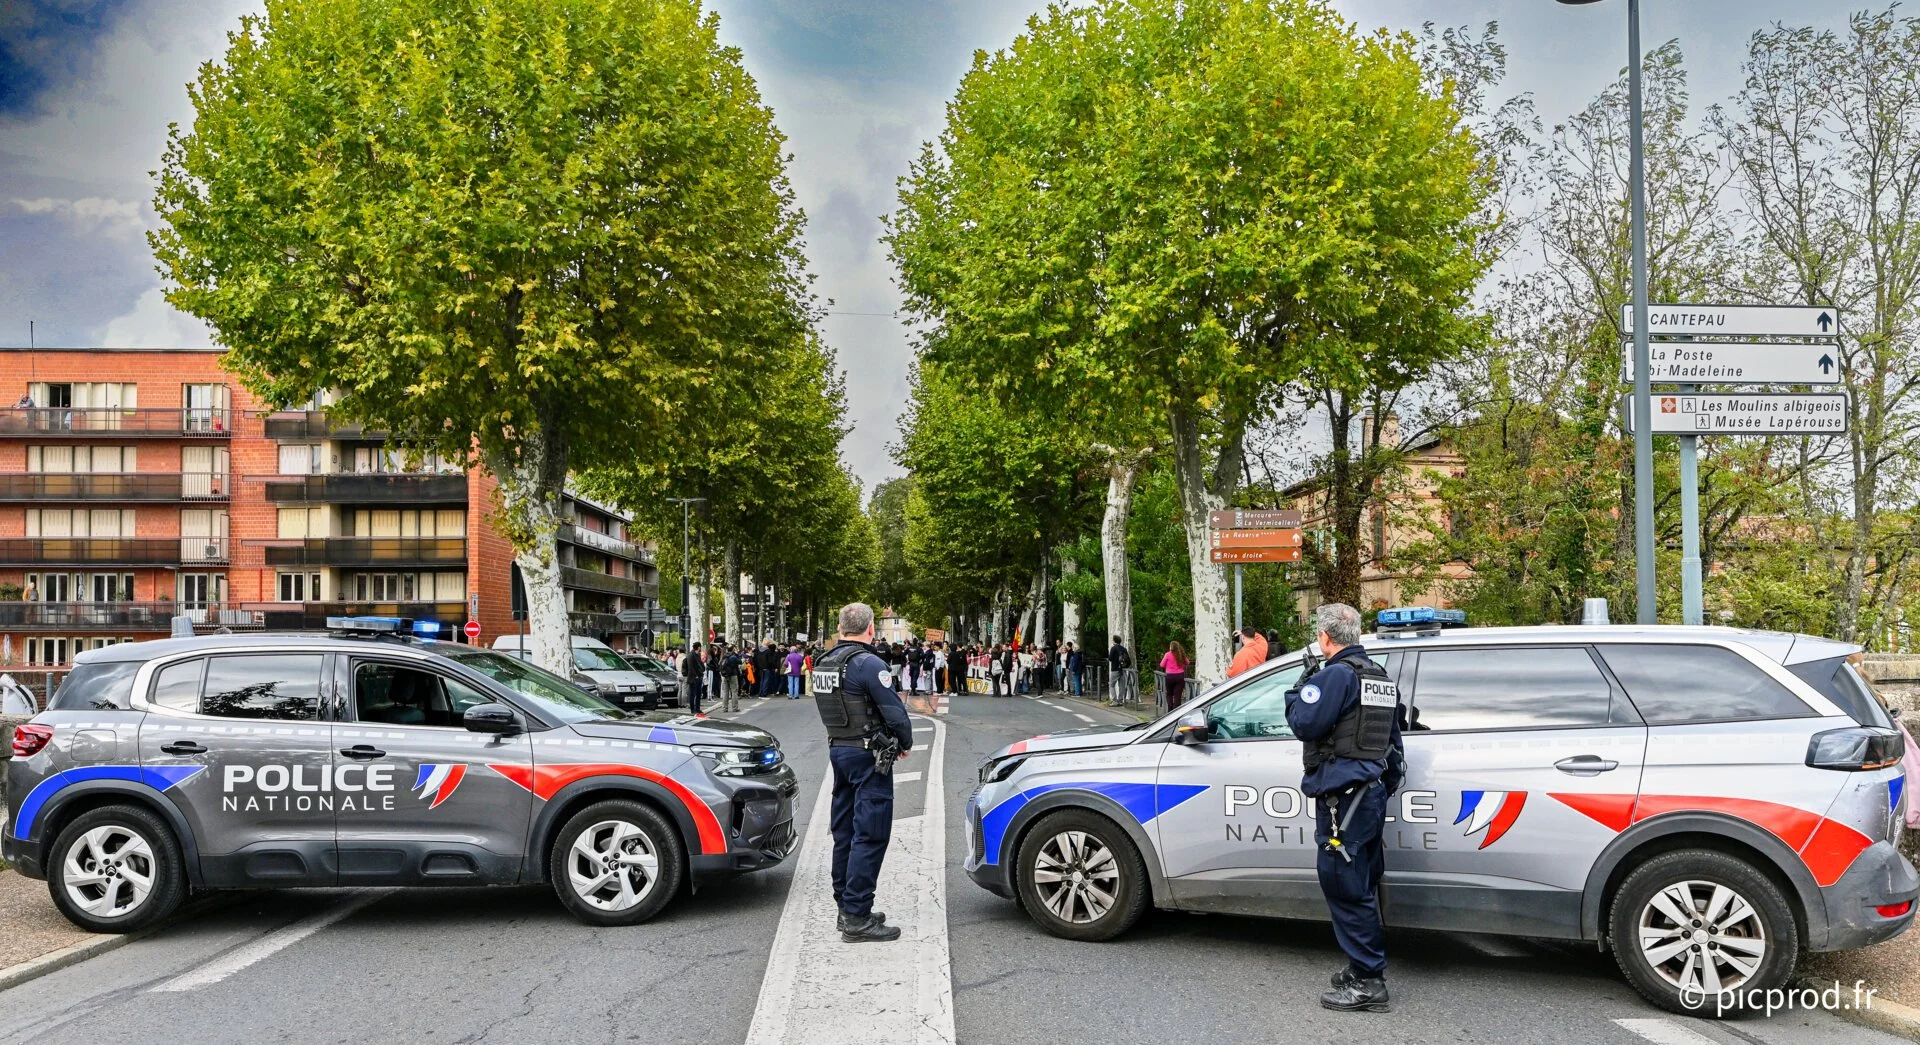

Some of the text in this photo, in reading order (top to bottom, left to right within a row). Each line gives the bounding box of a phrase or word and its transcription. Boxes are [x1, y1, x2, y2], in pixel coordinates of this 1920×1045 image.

[1650, 313, 1726, 326] CANTEPAU
[1651, 349, 1713, 361] La Poste
[1632, 364, 1743, 377] bi-Madeleine
[1701, 400, 1841, 415] Les Moulins albigeois
[1715, 415, 1841, 430] Musée Lapérouse
[1364, 682, 1395, 697] POLICE
[1364, 695, 1395, 705] NATIONALE
[223, 764, 396, 793] POLICE
[222, 795, 396, 812] NATIONALE
[1224, 784, 1438, 824] POE
[1225, 823, 1439, 851] NATILE
